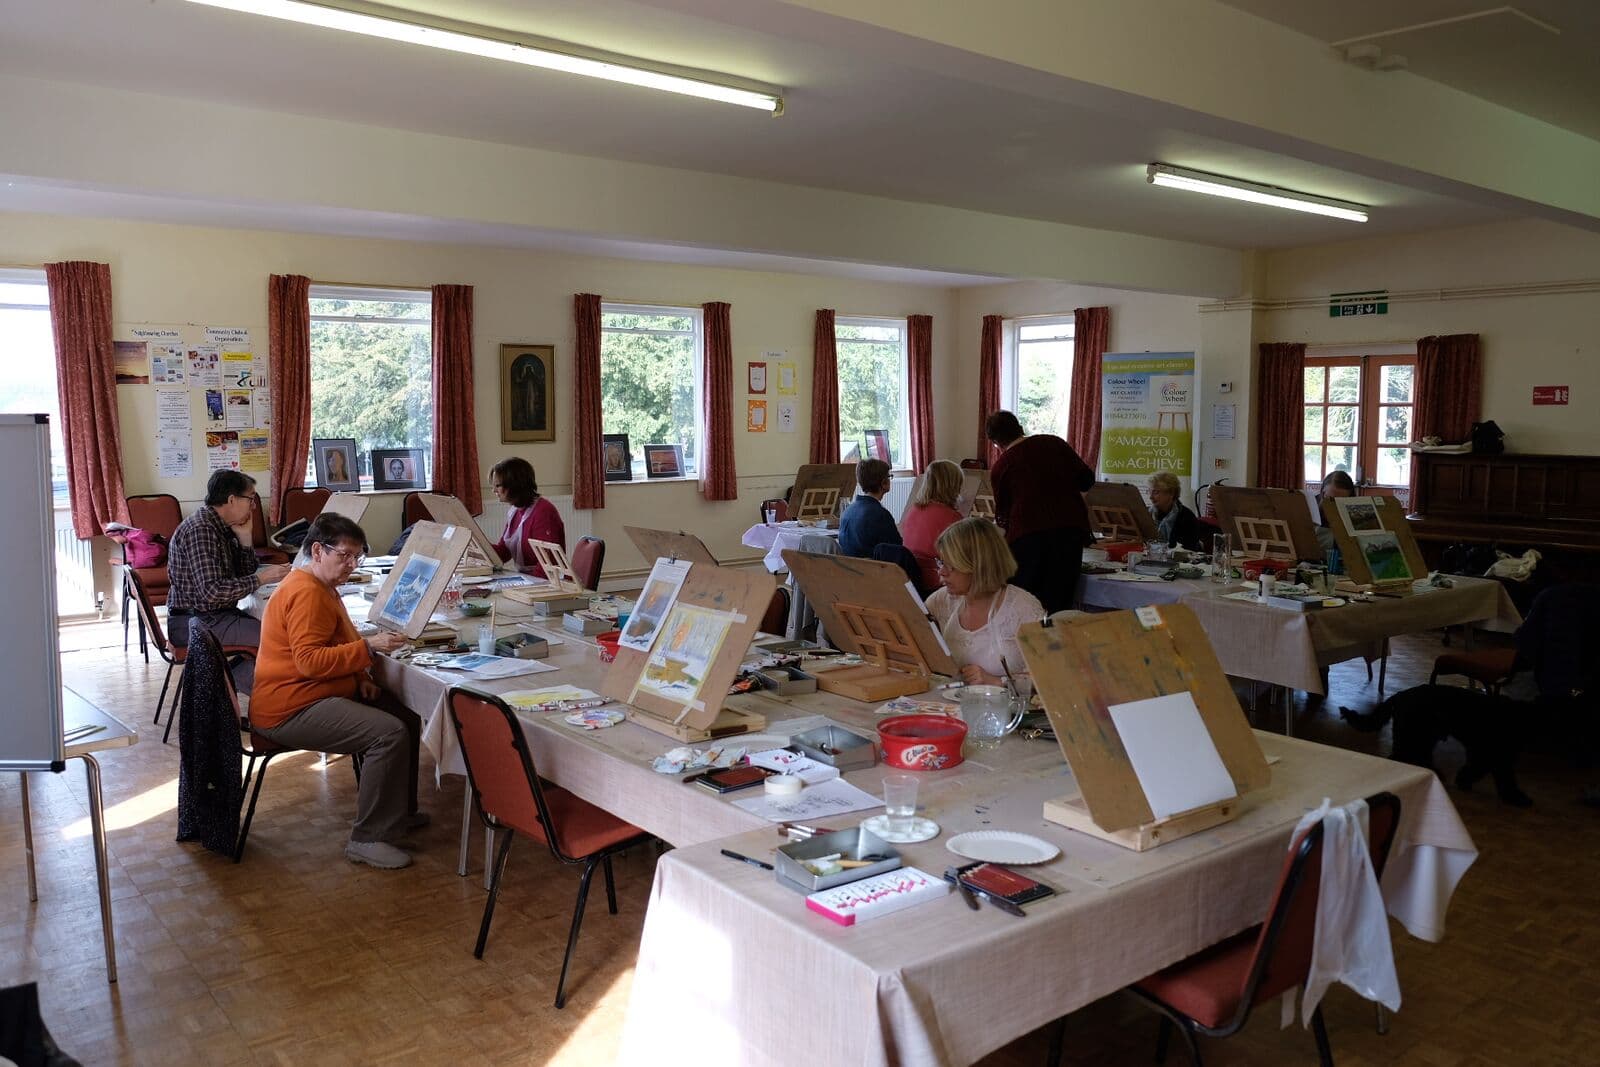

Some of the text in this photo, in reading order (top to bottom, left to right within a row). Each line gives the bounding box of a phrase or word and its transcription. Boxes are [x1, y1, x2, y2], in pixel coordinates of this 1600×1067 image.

[1164, 388, 1188, 396] Colour
[1115, 435, 1169, 447] AMAZED
[1153, 448, 1176, 457] YOU
[1105, 457, 1185, 470] CAN ACHIEVE
